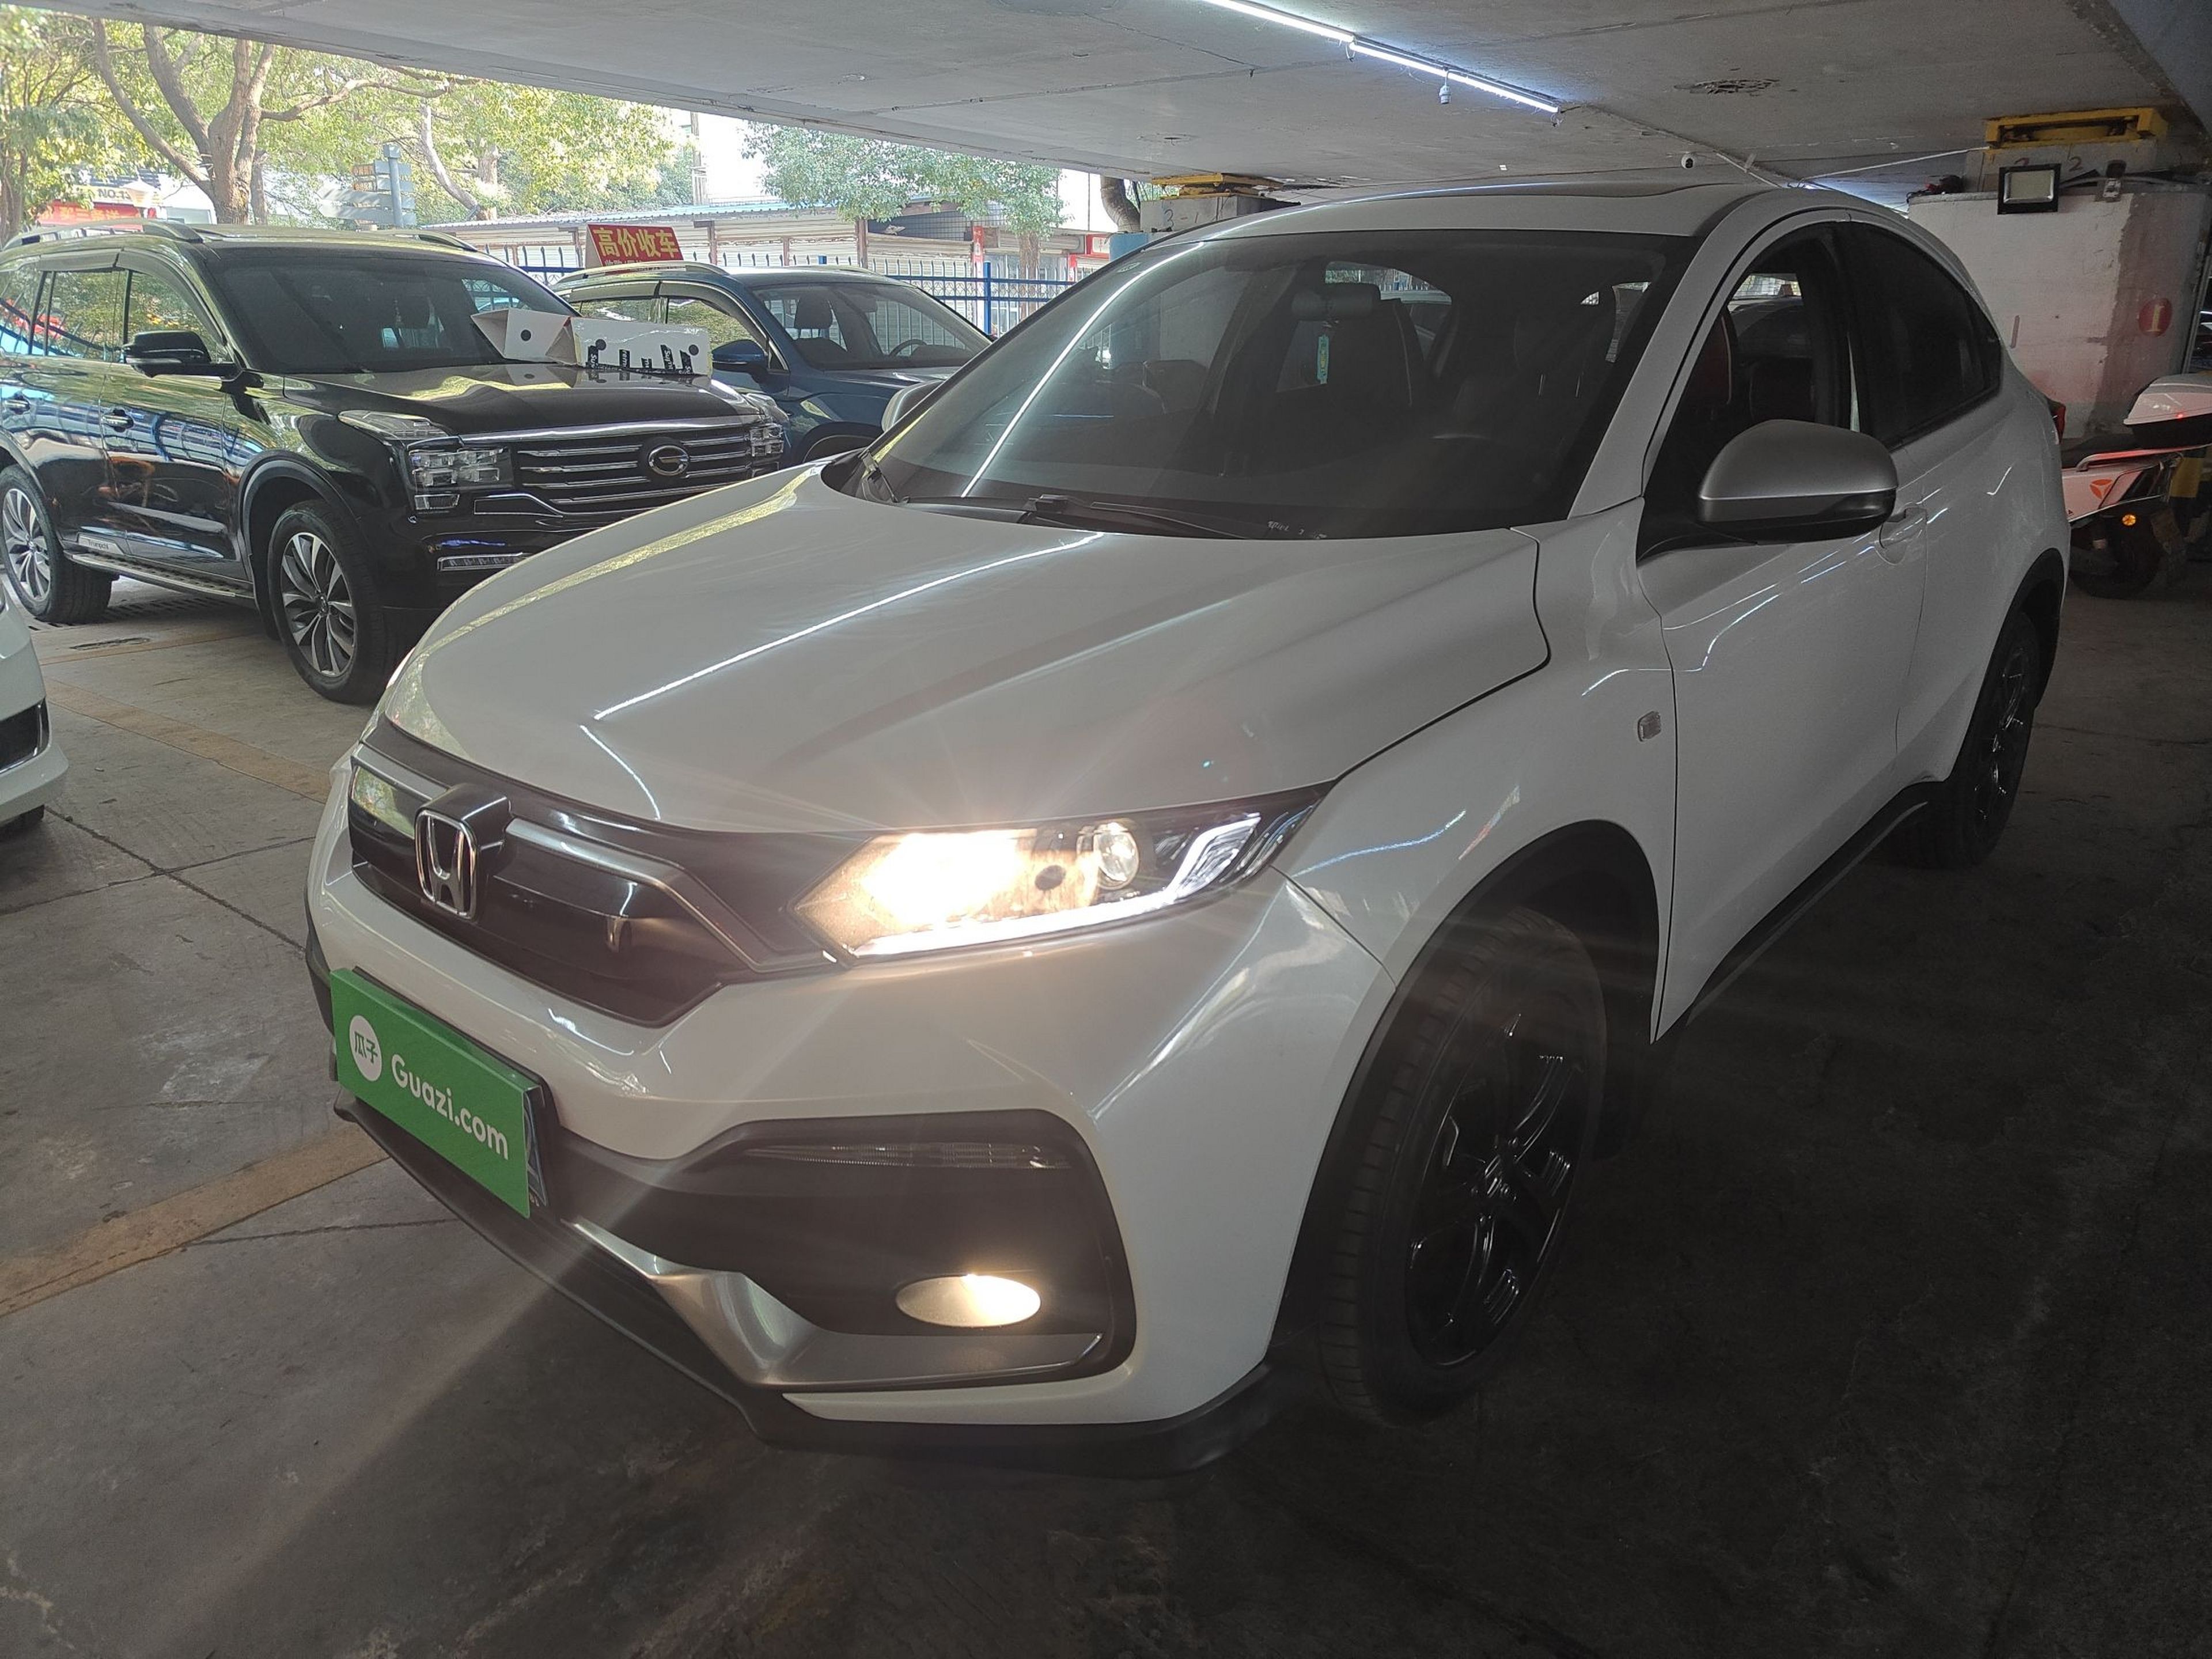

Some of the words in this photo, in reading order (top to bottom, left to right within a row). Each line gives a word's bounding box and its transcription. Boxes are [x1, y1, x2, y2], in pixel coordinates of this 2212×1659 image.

[593, 228, 679, 257] 高价收车
[354, 1031, 378, 1064] 瓜子
[391, 1054, 509, 1160] Guazi.com
